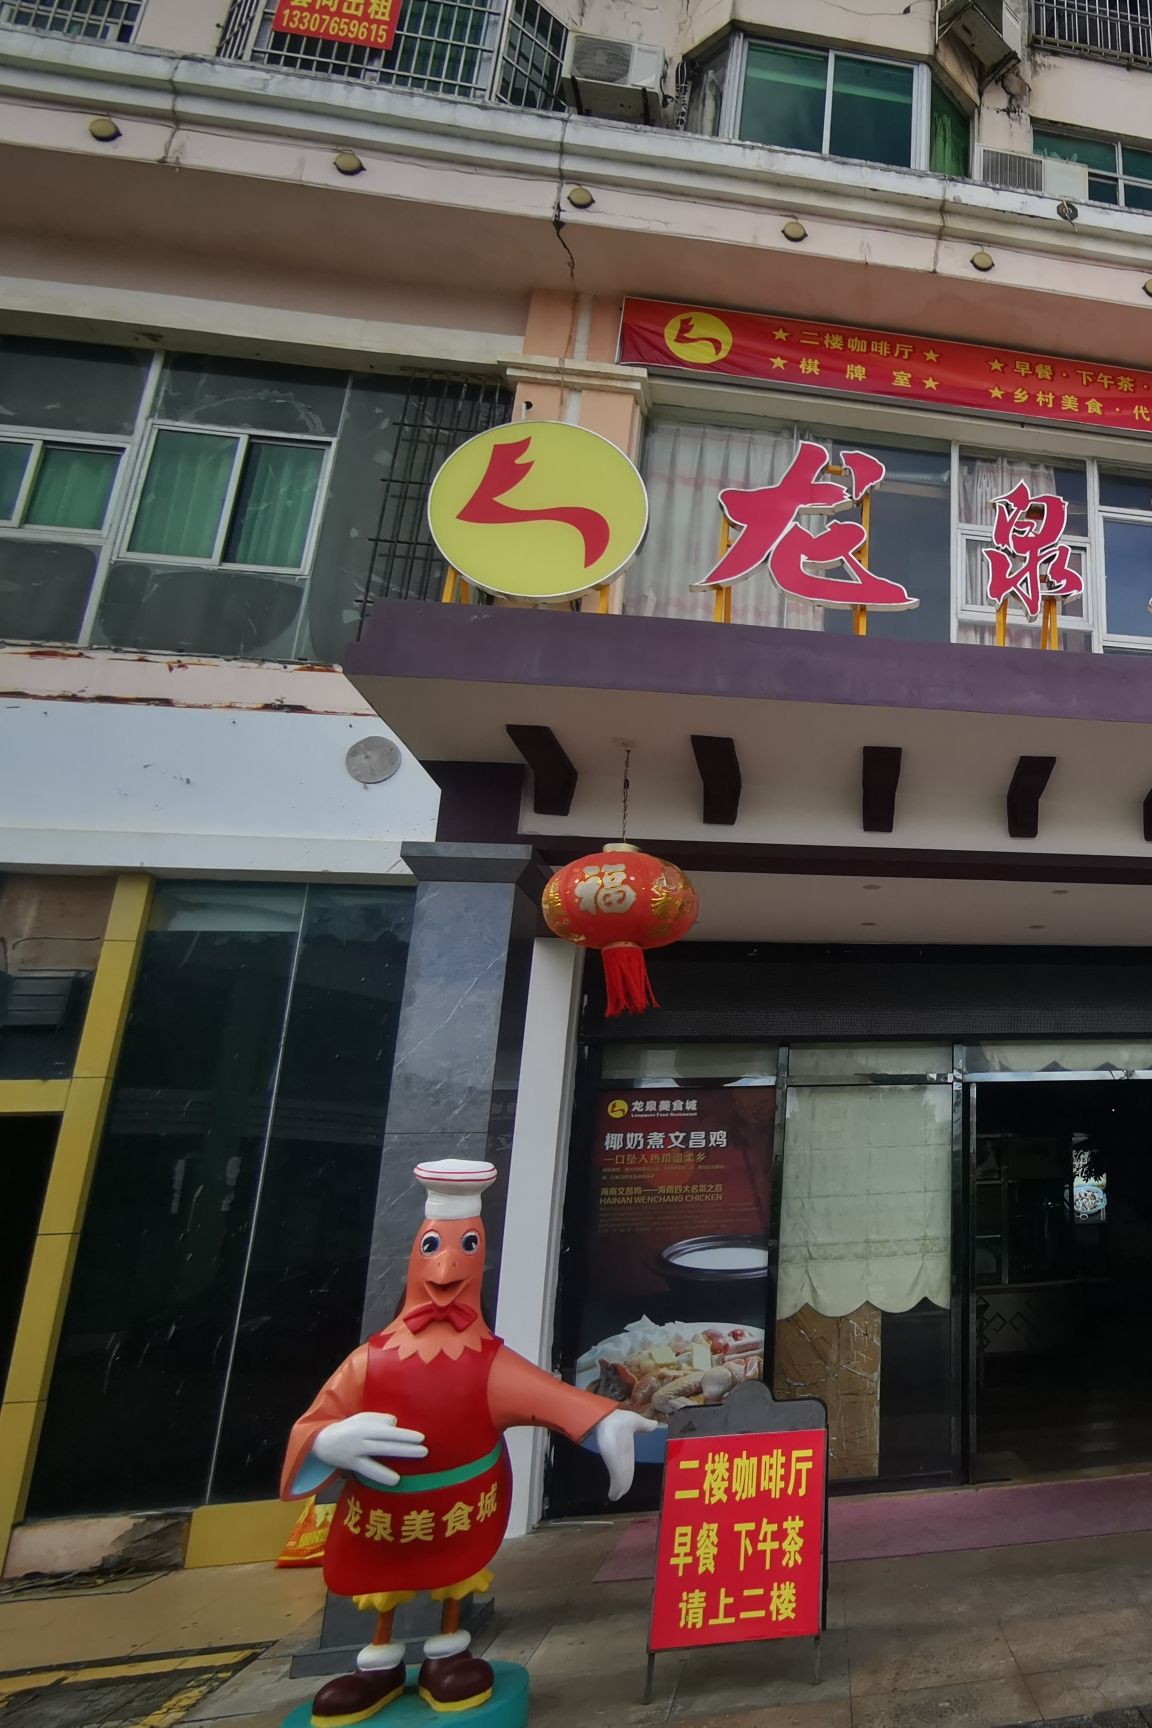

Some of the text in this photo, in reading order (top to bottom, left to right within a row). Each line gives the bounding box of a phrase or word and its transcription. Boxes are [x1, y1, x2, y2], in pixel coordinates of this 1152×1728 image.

[281, 8, 389, 43] 13307659615
[799, 331, 914, 360] 二楼咖啡厅
[798, 357, 912, 388] 棋牌室
[574, 863, 637, 916] 福
[631, 1099, 698, 1112] 龙泉美食城
[604, 1130, 727, 1151] 椰奶煮文昌鸡
[599, 1192, 723, 1205] HAINAN WENCHANG CHICKEN
[674, 1449, 814, 1505] 二楼咖啡厅
[343, 1482, 499, 1544] 龙泉美食城
[669, 1515, 804, 1577] 早餐 下午茶
[678, 1581, 797, 1630] 请上二楼
